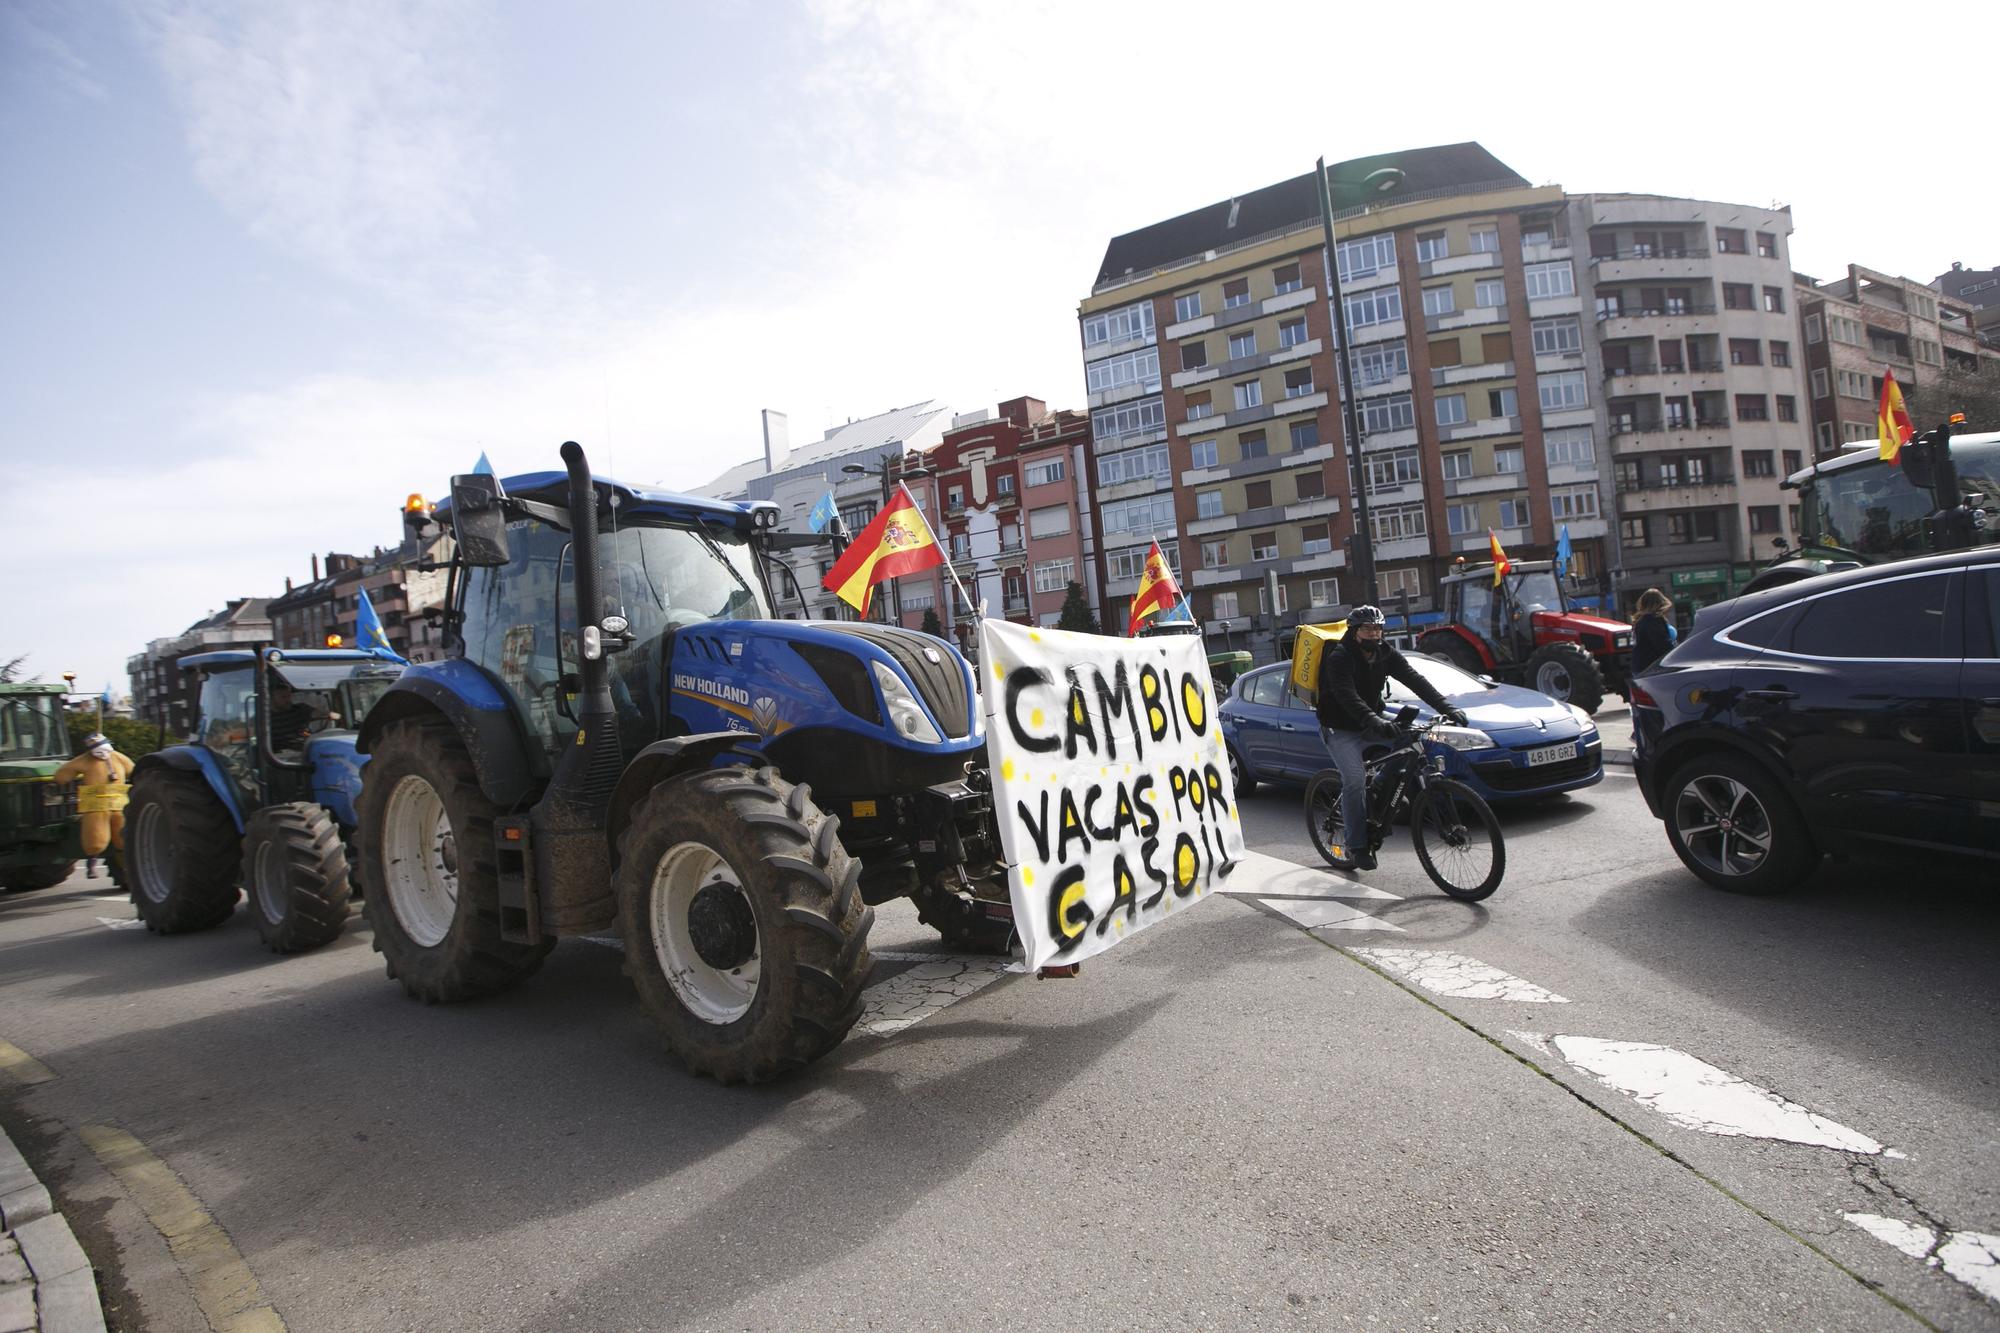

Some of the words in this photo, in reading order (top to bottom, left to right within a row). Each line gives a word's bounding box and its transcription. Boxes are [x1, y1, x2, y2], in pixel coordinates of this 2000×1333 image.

[674, 674, 696, 690] NEW
[697, 679, 749, 706] HOLLAND
[1005, 649, 1207, 762] CAMBIO
[1530, 750, 1555, 763] 4818
[1557, 746, 1576, 758] GRZ
[1017, 774, 1159, 864] VACAS
[1169, 763, 1229, 822] POR
[1047, 824, 1236, 956] GASOIL
